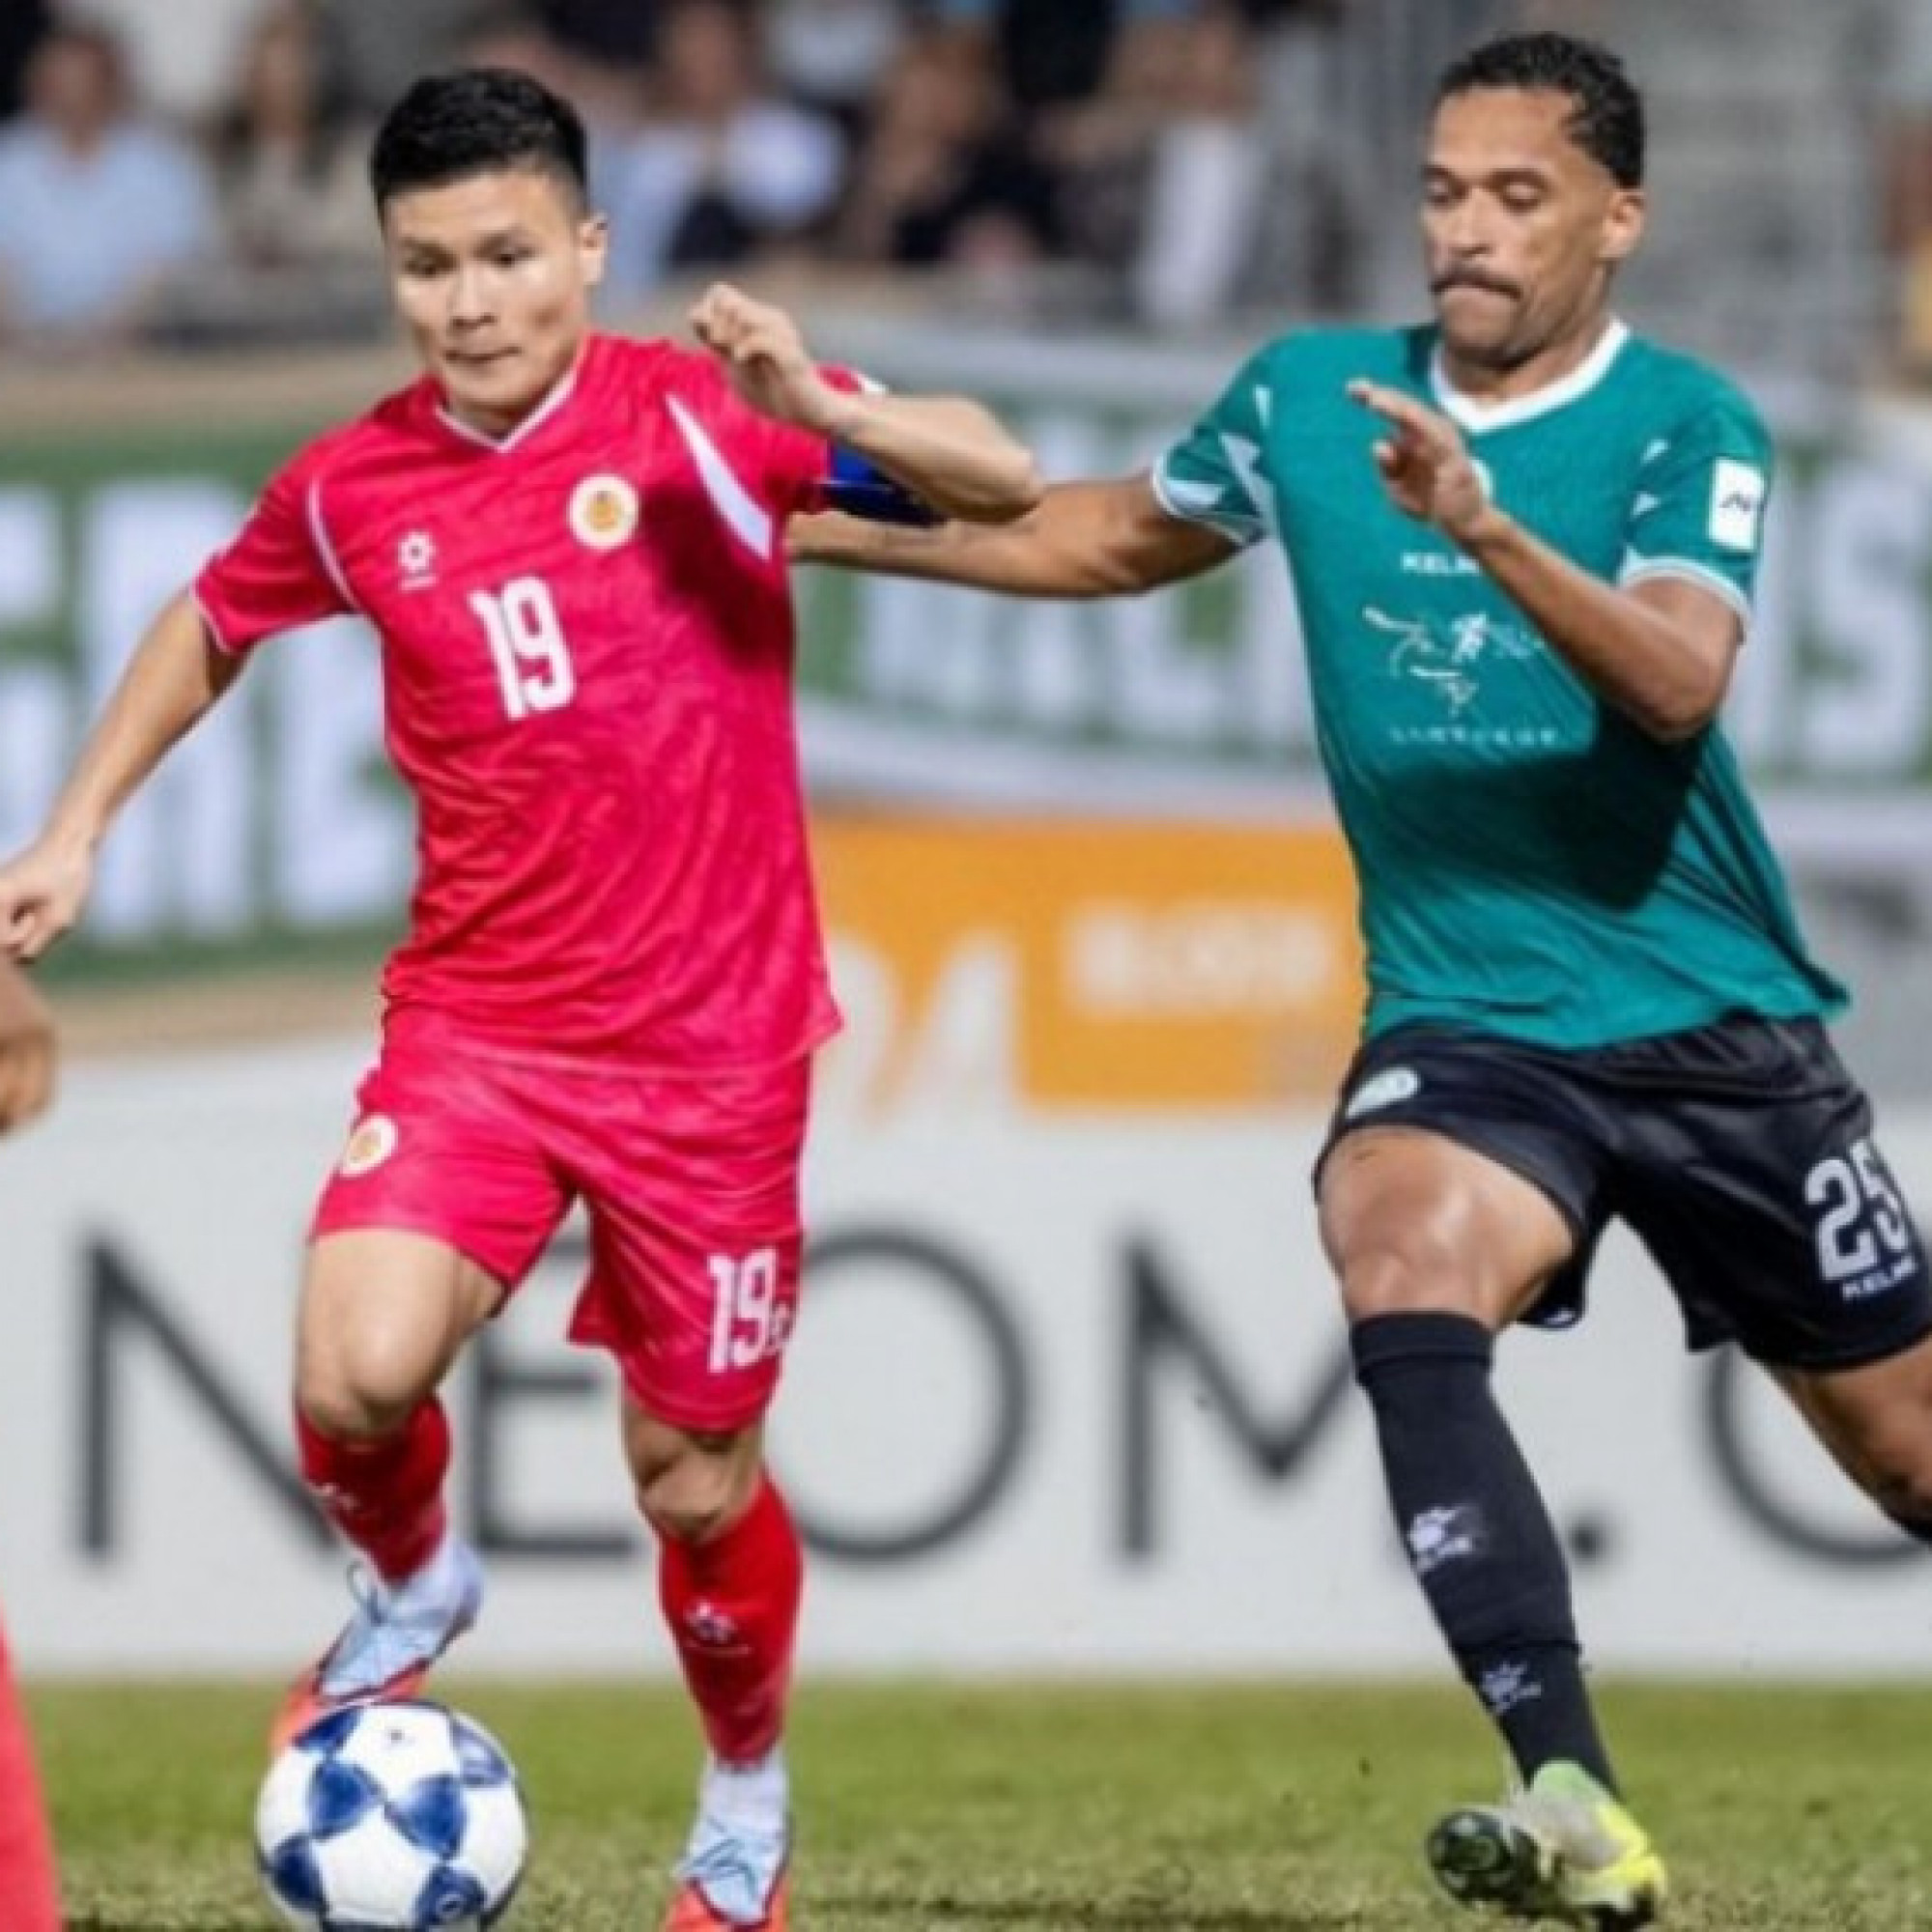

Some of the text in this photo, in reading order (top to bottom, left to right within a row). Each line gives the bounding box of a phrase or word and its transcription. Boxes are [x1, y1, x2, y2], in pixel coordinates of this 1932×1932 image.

[468, 576, 578, 721] 19
[1804, 1140, 1908, 1280] 25
[707, 1247, 777, 1373] 19
